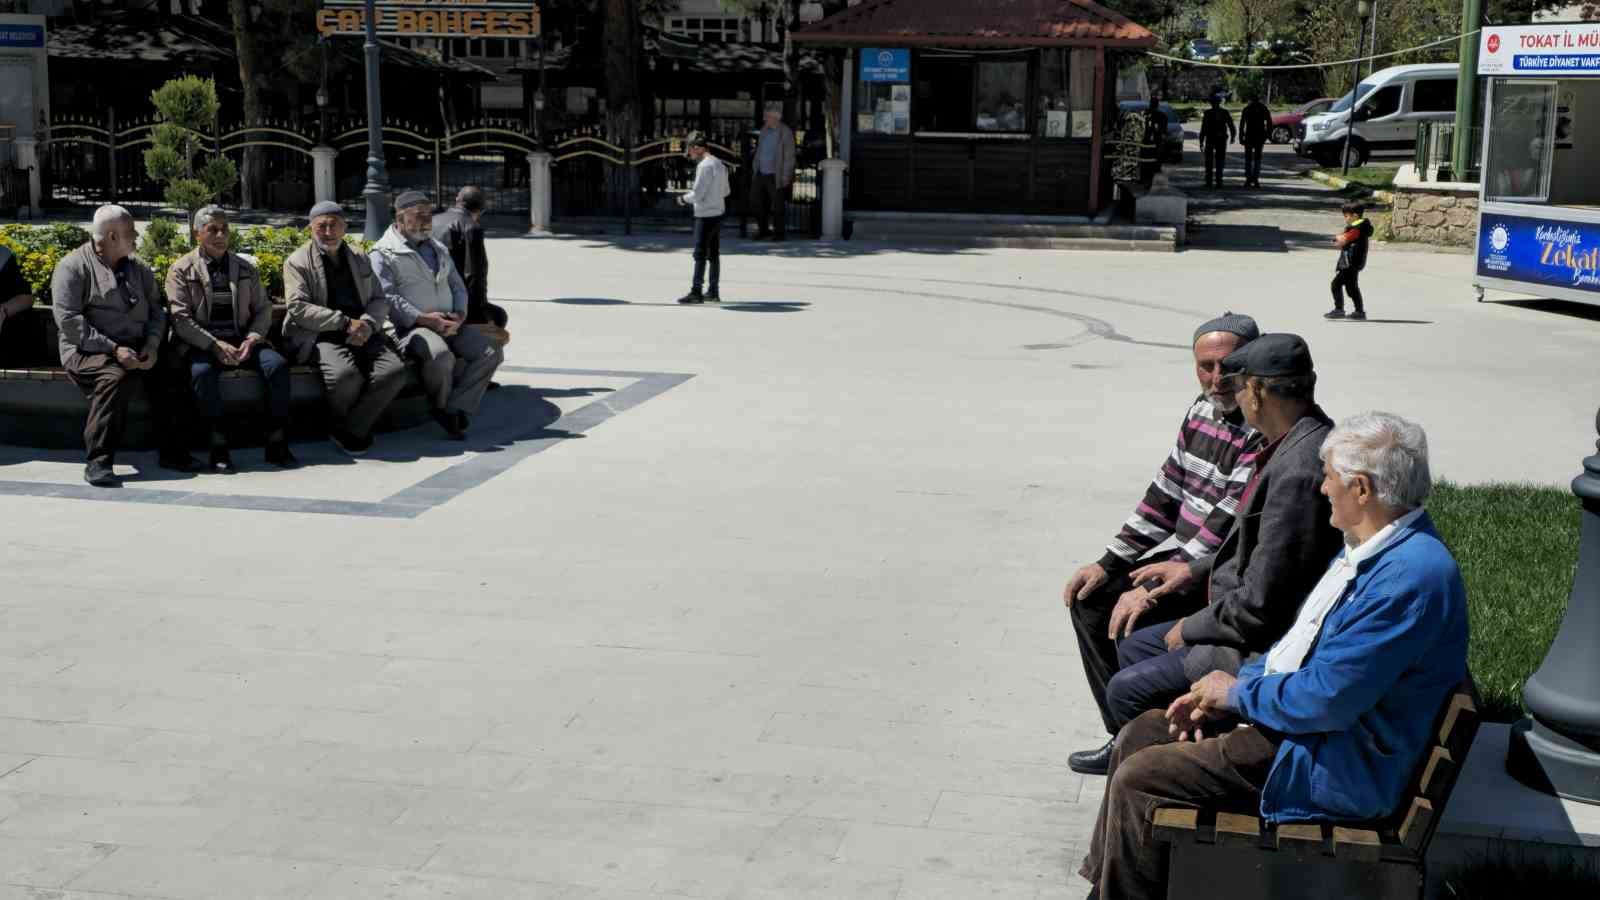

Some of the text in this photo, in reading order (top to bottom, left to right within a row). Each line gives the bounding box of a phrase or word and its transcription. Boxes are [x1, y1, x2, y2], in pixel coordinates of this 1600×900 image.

[1519, 28, 1600, 48] TOKAT İL MÜ
[1519, 56, 1548, 67] TÜRKİYE
[1549, 55, 1580, 67] DİYANET
